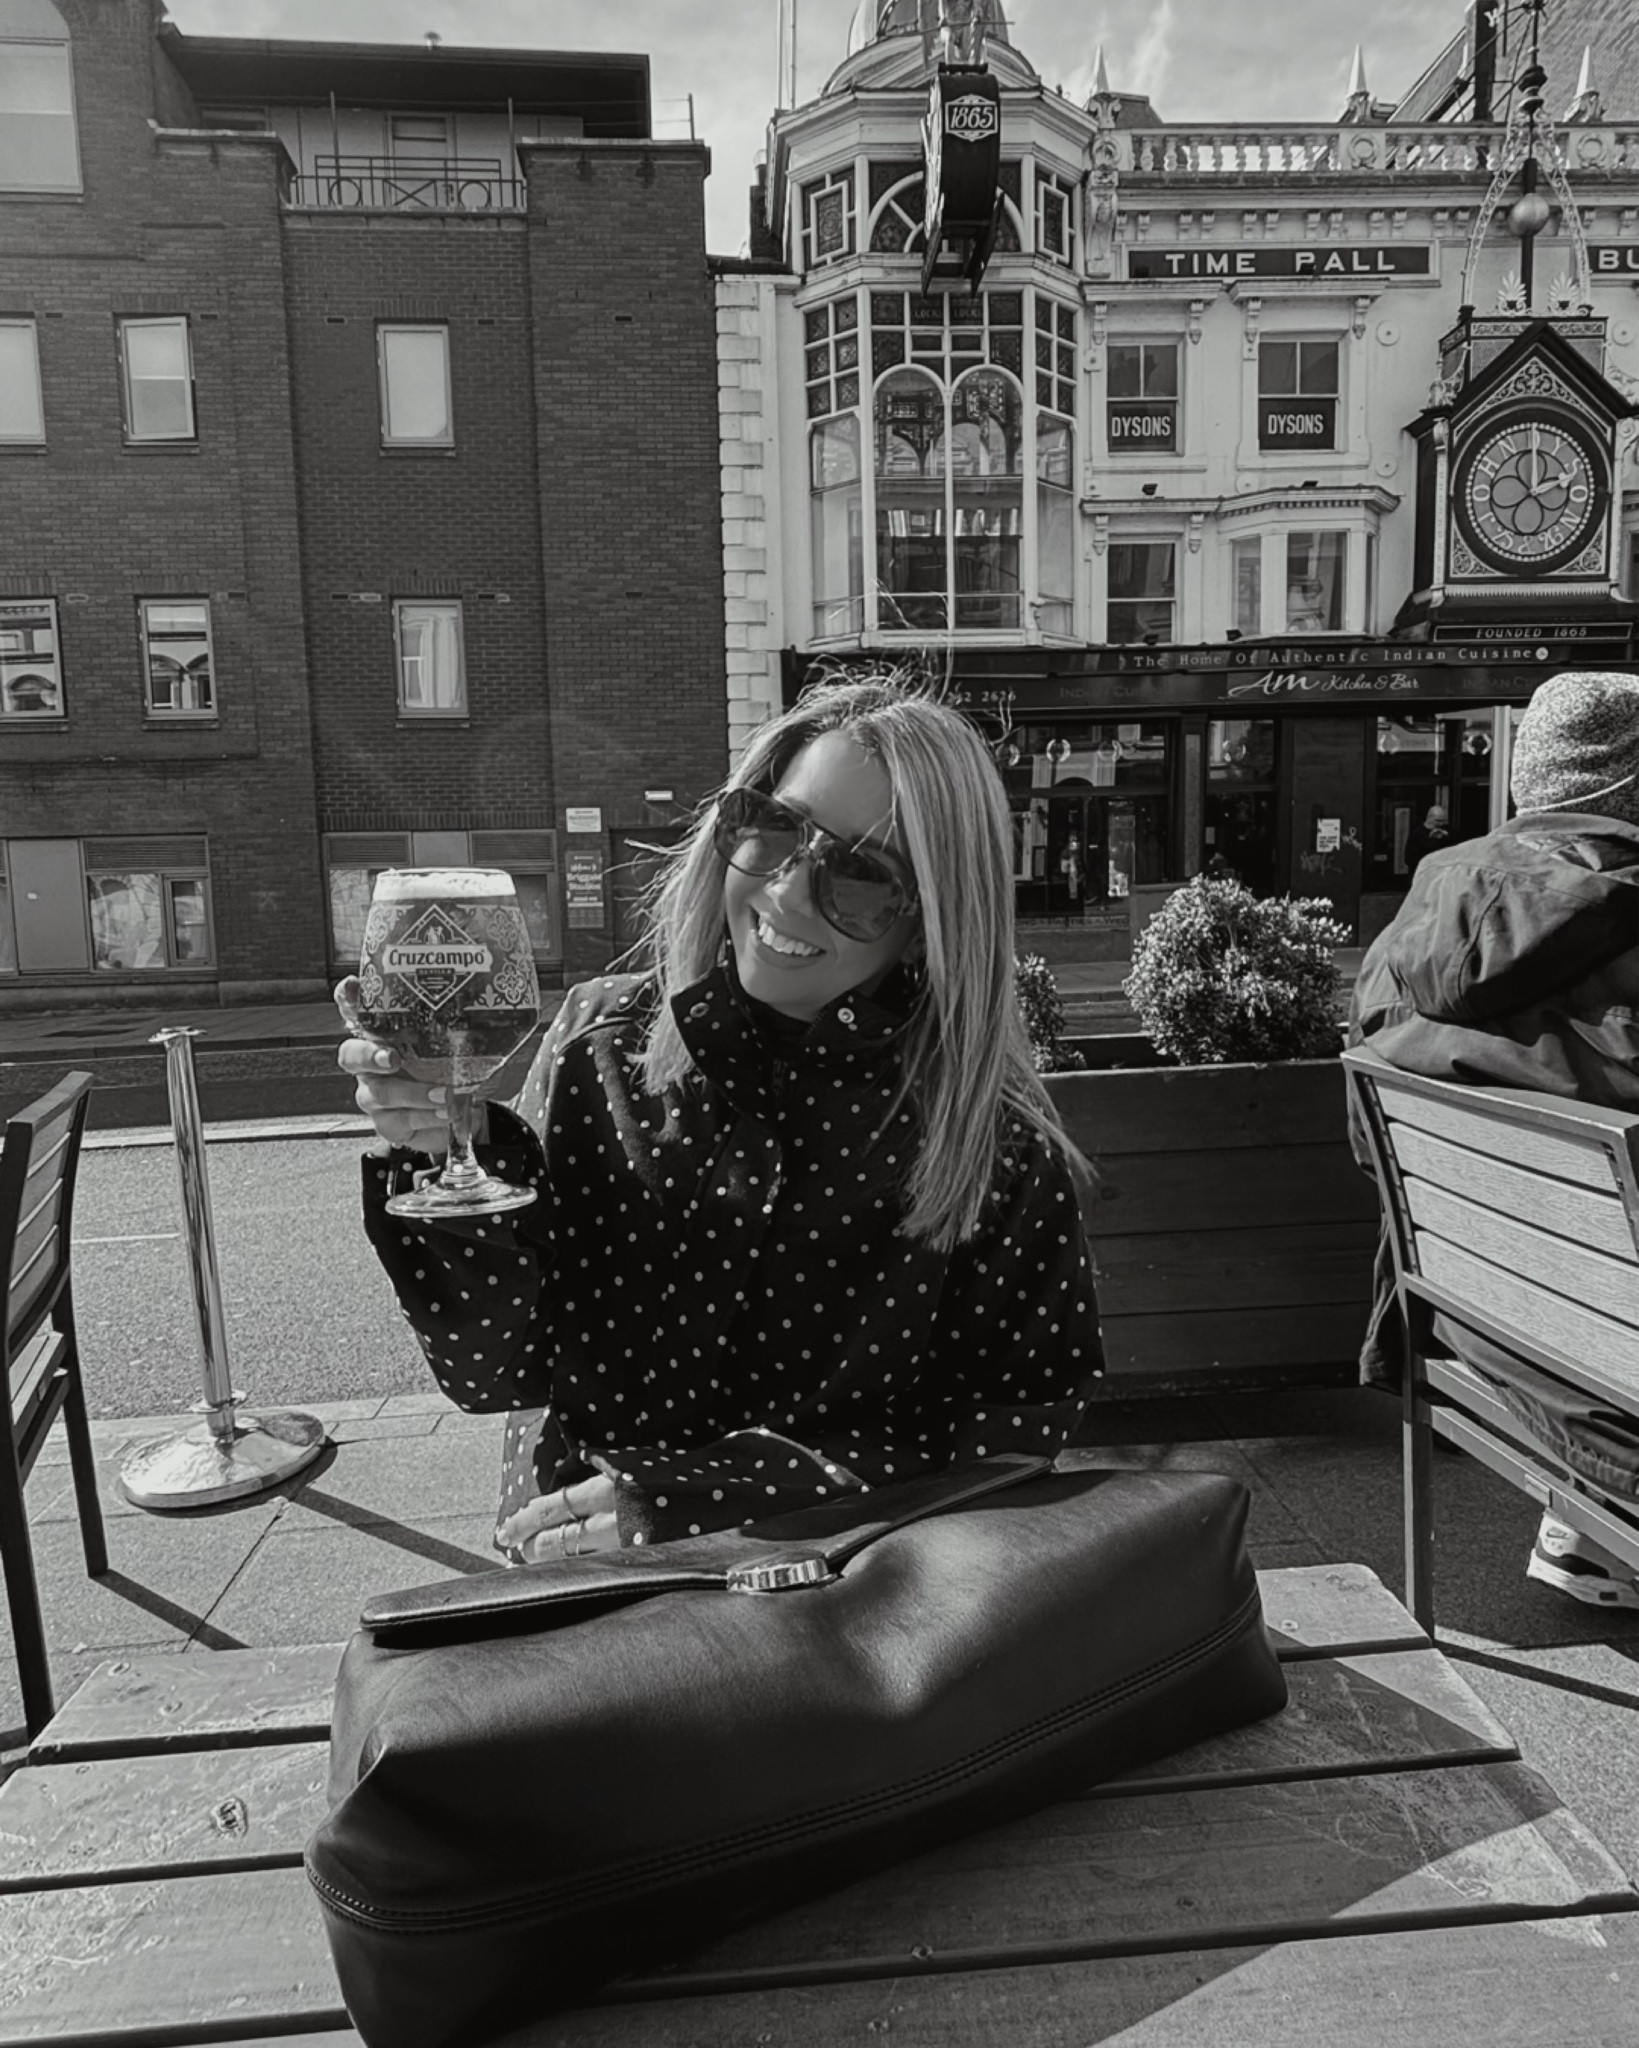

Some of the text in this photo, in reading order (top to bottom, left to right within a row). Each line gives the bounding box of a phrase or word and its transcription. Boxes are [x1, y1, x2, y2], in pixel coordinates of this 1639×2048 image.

[951, 106, 994, 129] 1865
[1165, 252, 1256, 274] TIME
[1111, 416, 1171, 437] DYSONS
[1267, 414, 1324, 435] DYSONS
[1475, 627, 1543, 639] FOUNDED
[1133, 655, 1165, 668] The
[1179, 653, 1222, 667] Home
[1269, 650, 1370, 665] Authentic
[1383, 649, 1446, 662] Indian
[1458, 647, 1532, 661] Cuisine
[1374, 675, 1389, 690] &
[1389, 672, 1420, 690] Bar
[389, 948, 485, 968] Cruzcampo
